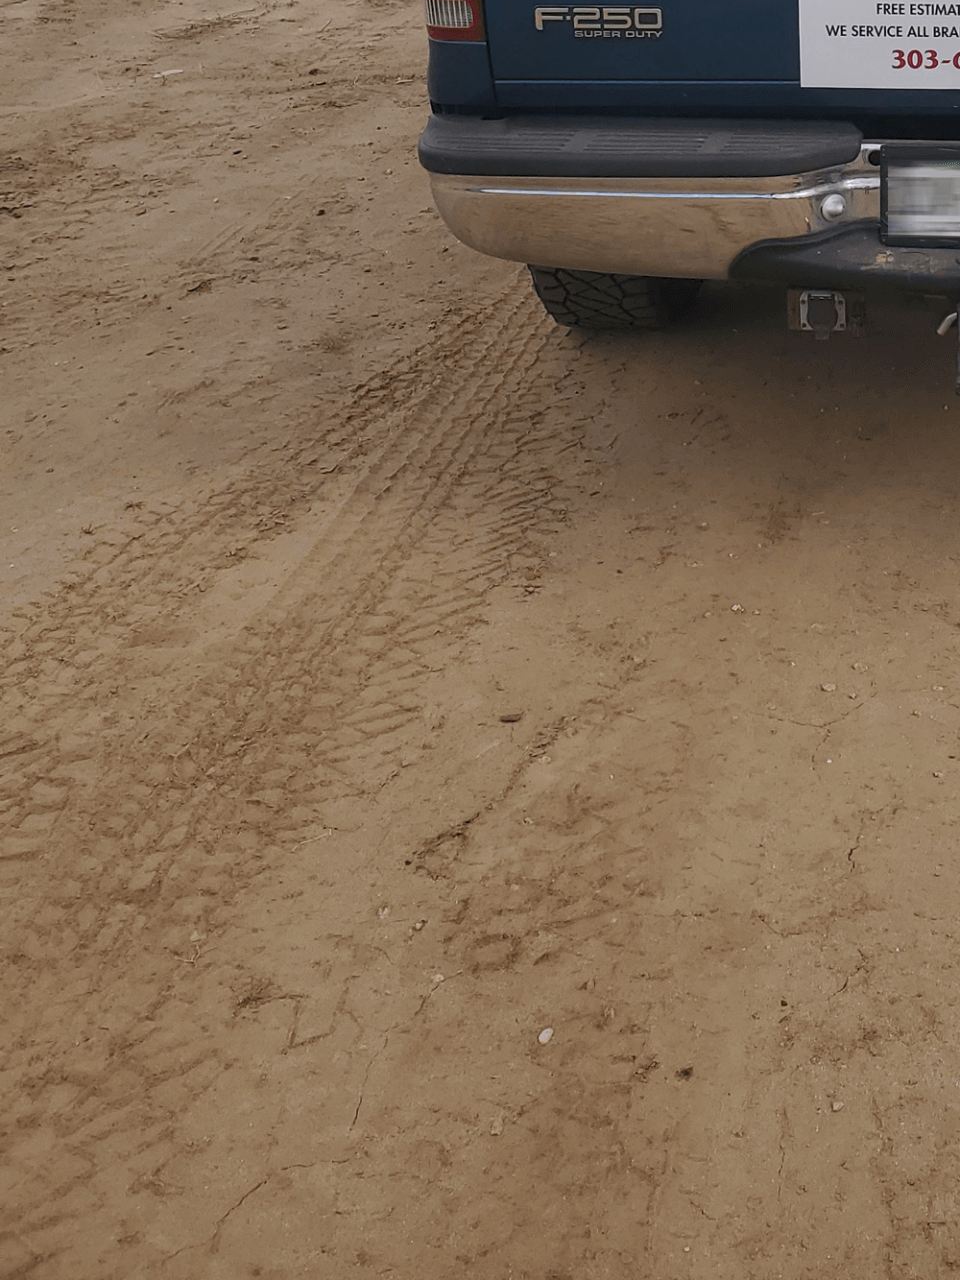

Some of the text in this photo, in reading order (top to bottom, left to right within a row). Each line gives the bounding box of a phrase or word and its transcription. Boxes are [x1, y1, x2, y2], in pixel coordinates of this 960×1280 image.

[876, 3, 905, 16] FREE
[574, 30, 621, 38] SUPER
[825, 25, 847, 37] WE
[851, 25, 903, 38] SERVICE
[906, 26, 929, 38] ALL
